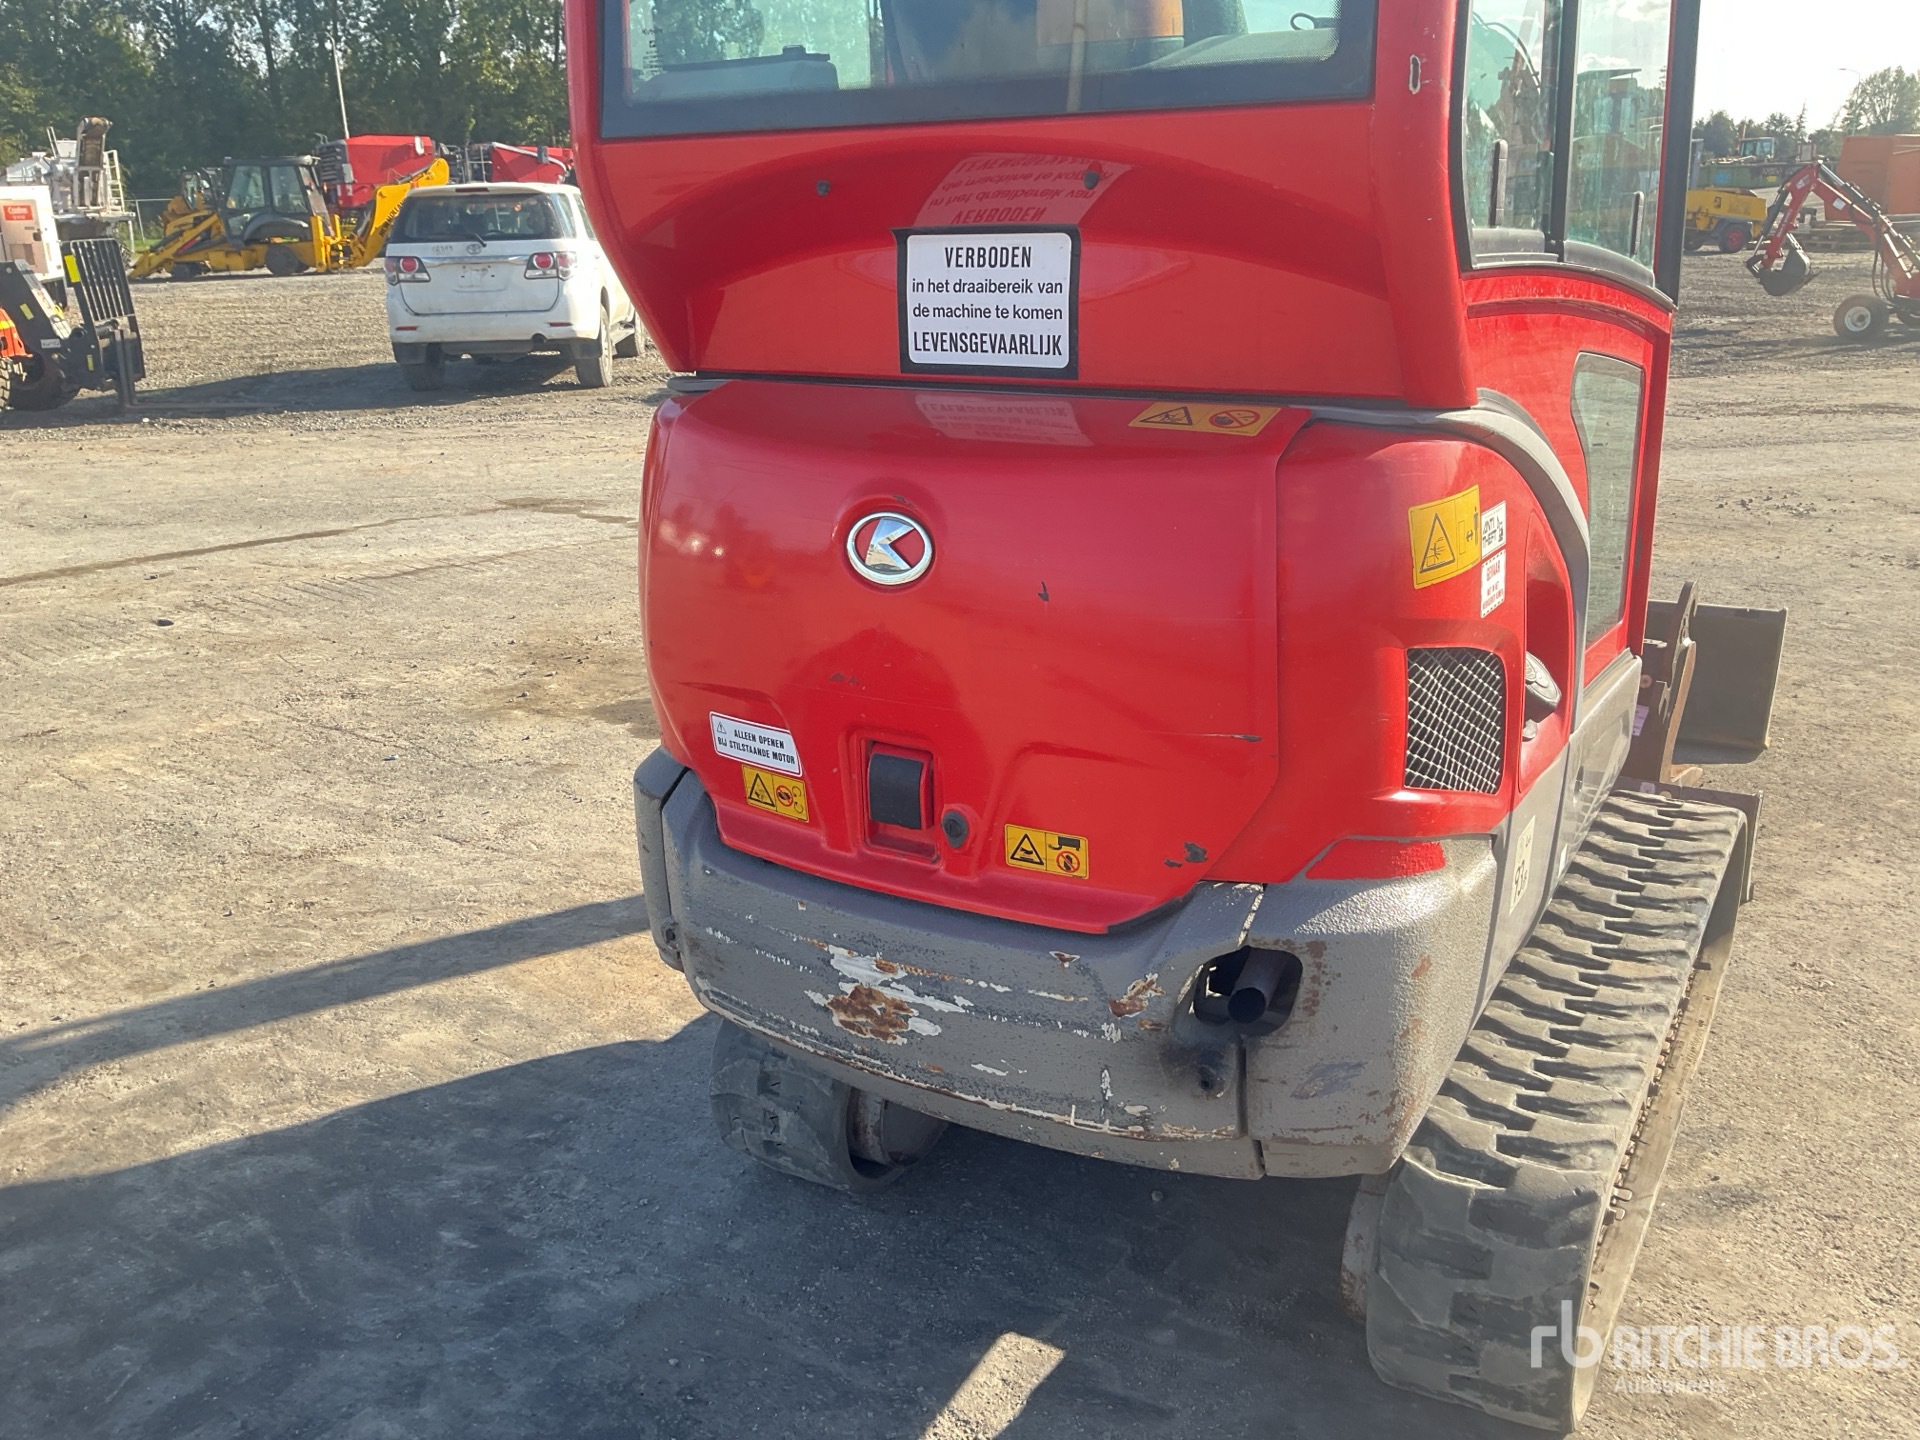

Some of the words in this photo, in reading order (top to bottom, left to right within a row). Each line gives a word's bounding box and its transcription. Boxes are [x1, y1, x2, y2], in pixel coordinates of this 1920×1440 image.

[945, 246, 1032, 268] VERBODEN
[912, 278, 924, 293] in
[927, 278, 950, 293] het
[953, 278, 1033, 294] draaibereik
[1037, 281, 1063, 294] van
[913, 303, 930, 318] de
[933, 303, 992, 319] machine
[995, 305, 1010, 319] te
[1013, 304, 1063, 320] komen
[913, 331, 1062, 356] LEVENSGEVAARLIJK
[734, 729, 757, 743] ALLEEN
[758, 735, 785, 750] OPENEN
[717, 736, 728, 747] BIJ
[729, 740, 771, 759] STILSTAANDE
[772, 751, 795, 765] MOTOR
